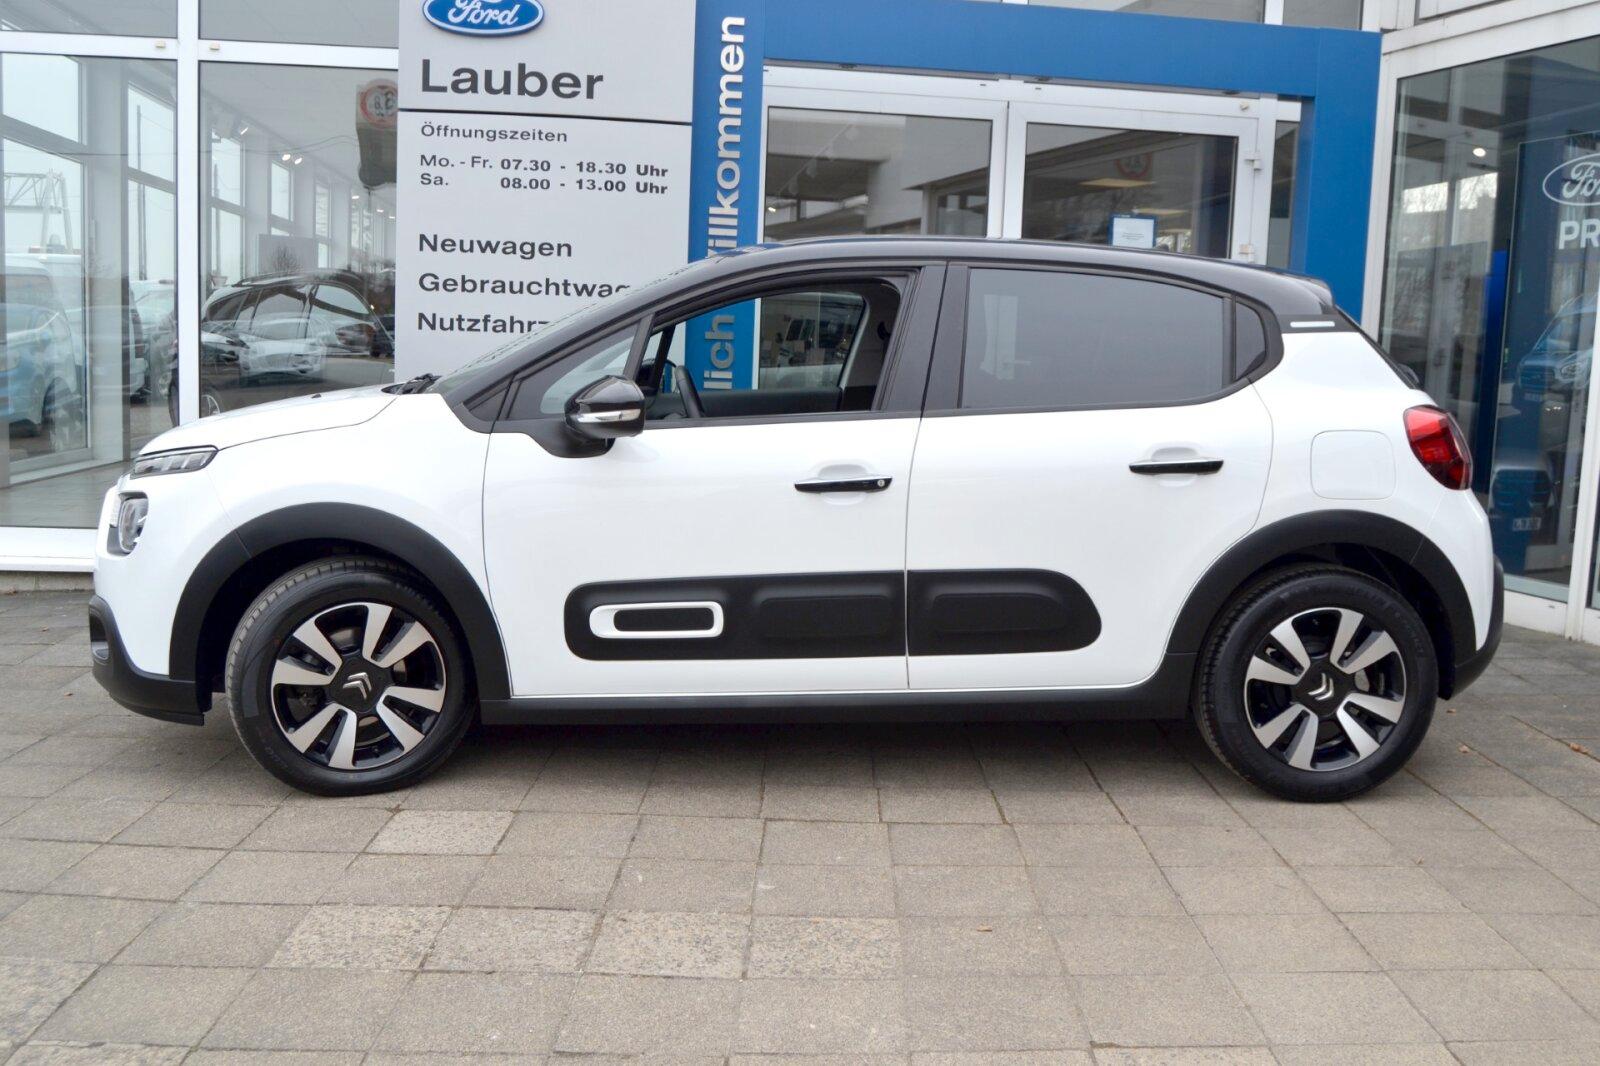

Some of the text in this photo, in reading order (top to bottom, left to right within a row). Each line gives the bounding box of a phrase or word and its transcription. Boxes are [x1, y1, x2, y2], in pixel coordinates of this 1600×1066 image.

[446, 0, 521, 26] Ford
[421, 58, 604, 100] Lauber
[420, 121, 568, 143] Öffnungszeiten
[707, 16, 745, 257] illkommen
[420, 154, 455, 168] Mo.
[470, 155, 493, 169] Fr.
[500, 158, 551, 172] 07.30
[576, 160, 627, 175] 18.30
[636, 163, 669, 178] Uhr
[420, 172, 449, 186] Sa.
[500, 176, 551, 190] 08.00
[575, 178, 627, 193] 13.00
[635, 181, 668, 195] Uhr
[419, 233, 572, 261] Neuwagen
[418, 312, 549, 334] Nutzfahr
